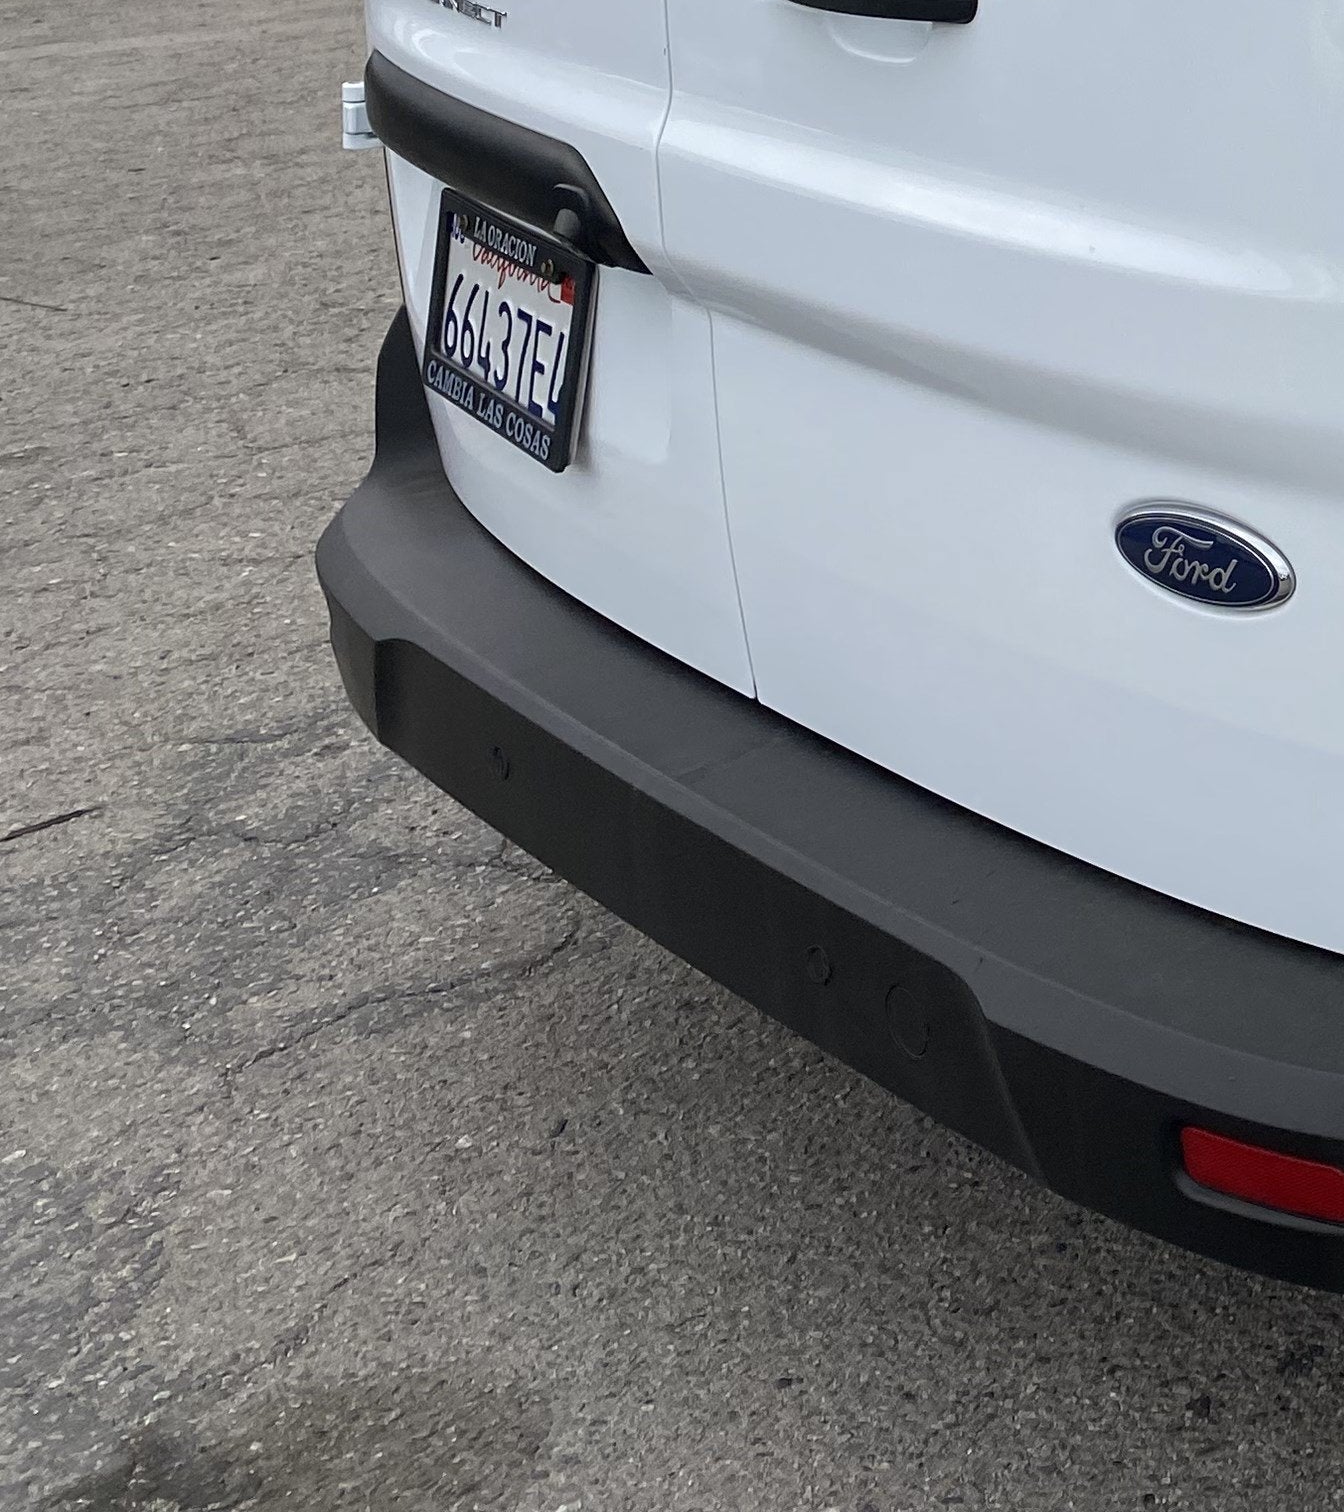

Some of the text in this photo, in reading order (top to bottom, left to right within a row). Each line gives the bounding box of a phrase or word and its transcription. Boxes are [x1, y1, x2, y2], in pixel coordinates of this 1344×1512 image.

[427, 359, 551, 461] CAMBIA LAS COSAS
[1143, 525, 1239, 594] Ford
